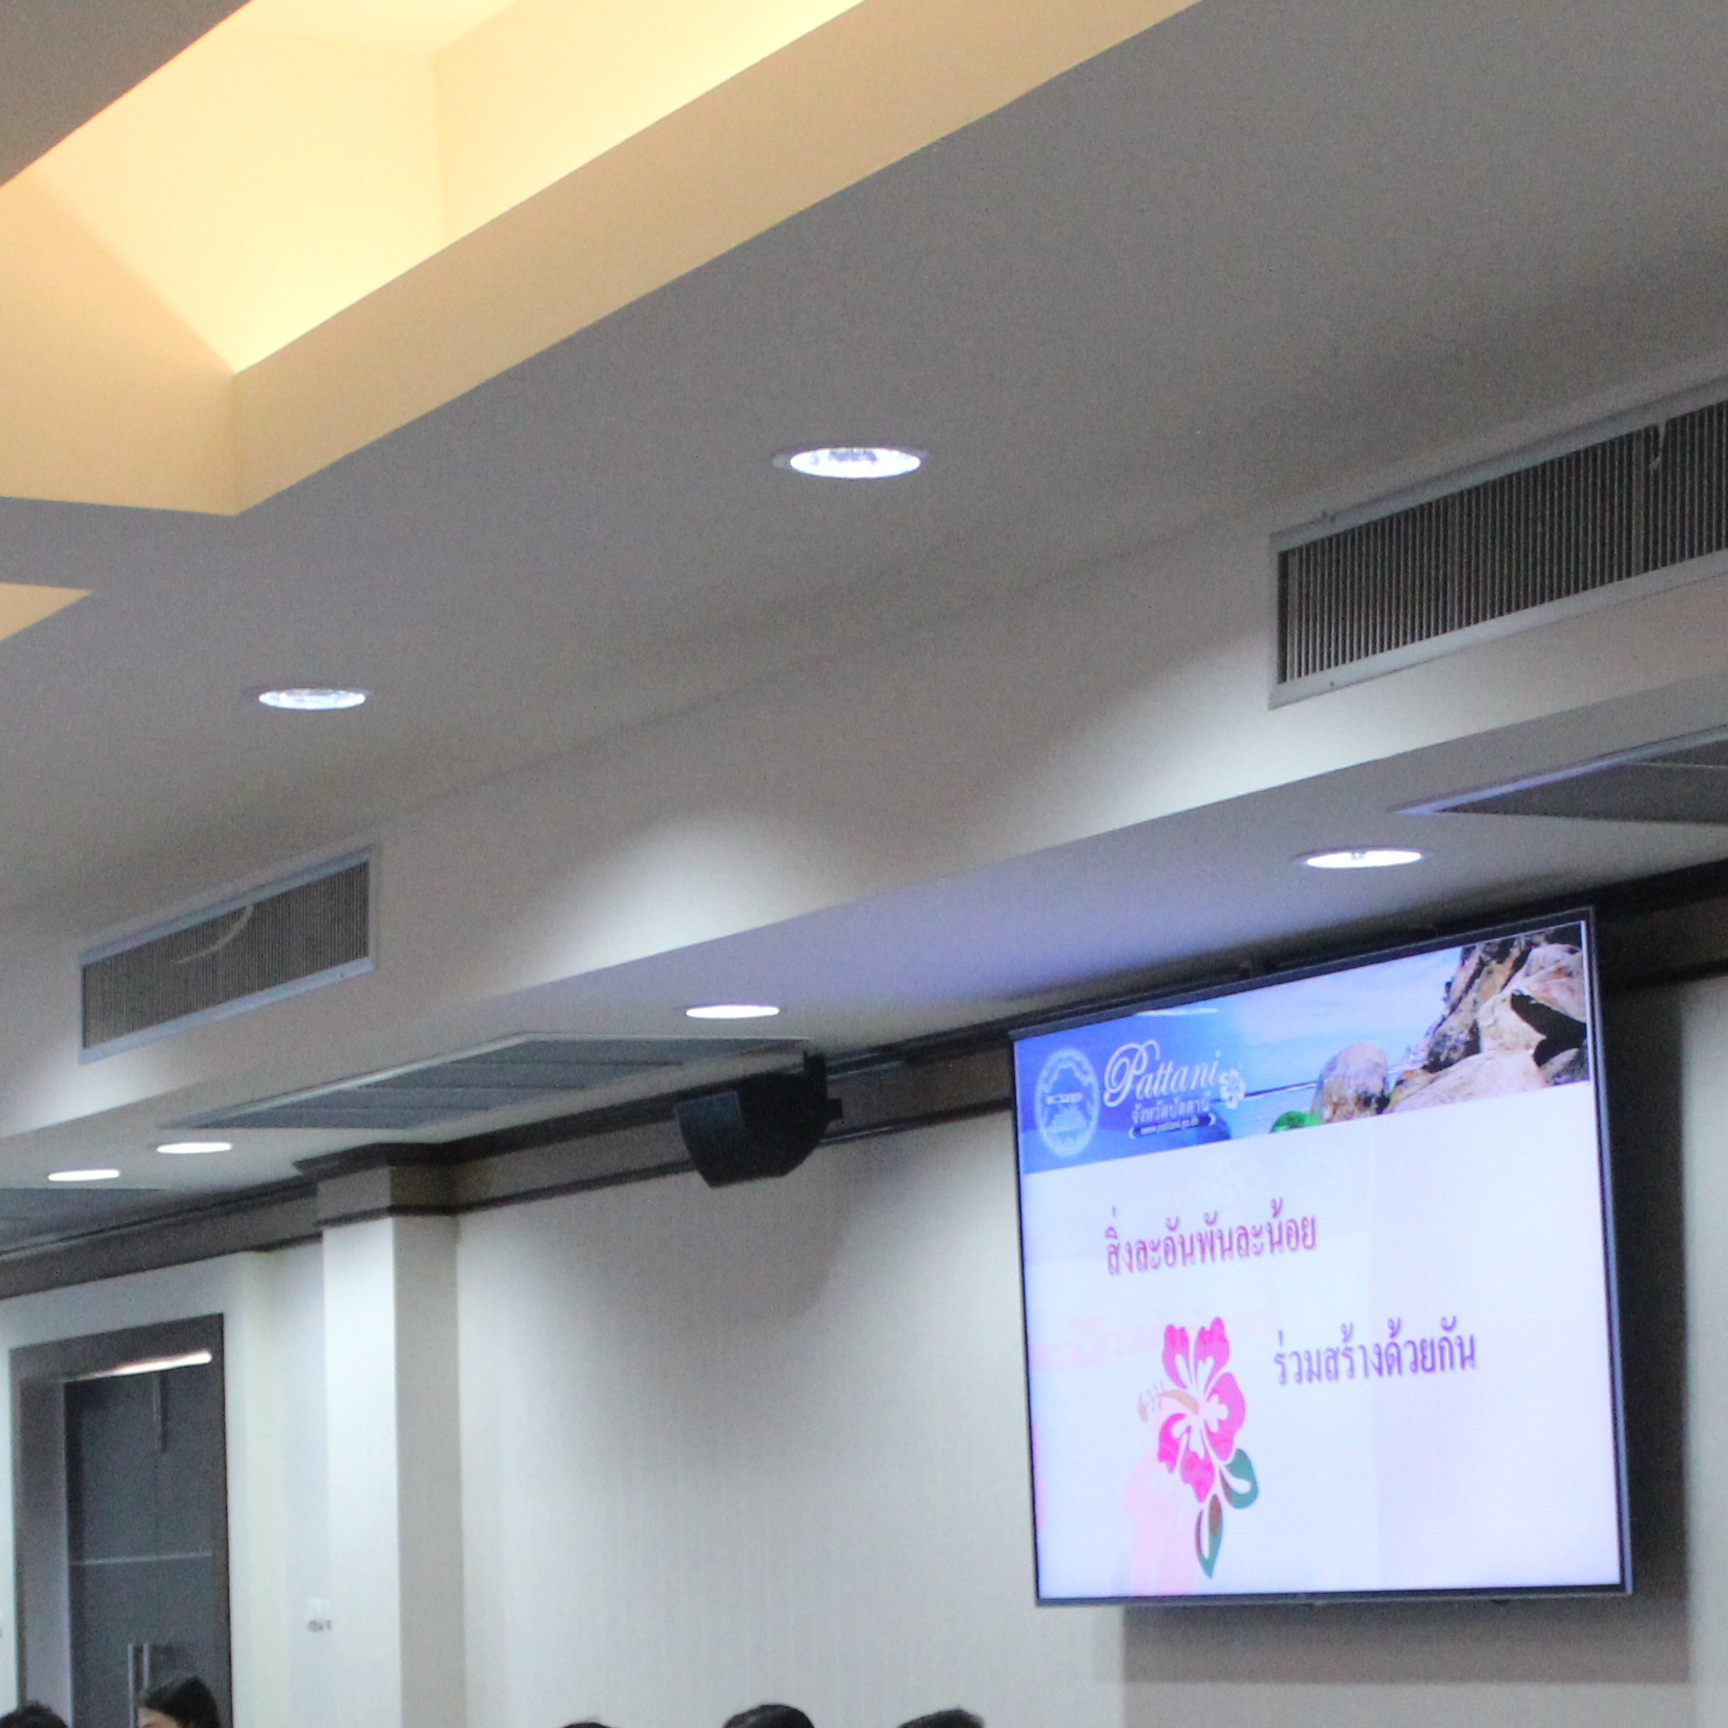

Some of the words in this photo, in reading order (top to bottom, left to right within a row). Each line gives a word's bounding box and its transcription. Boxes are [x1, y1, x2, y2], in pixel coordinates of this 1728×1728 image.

[1103, 1039, 1223, 1107] Pattani
[1104, 1197, 1316, 1275] สิ่งละอันพันละน้อย
[1273, 1315, 1476, 1386] ร่วมสร้างด้วยกัน
